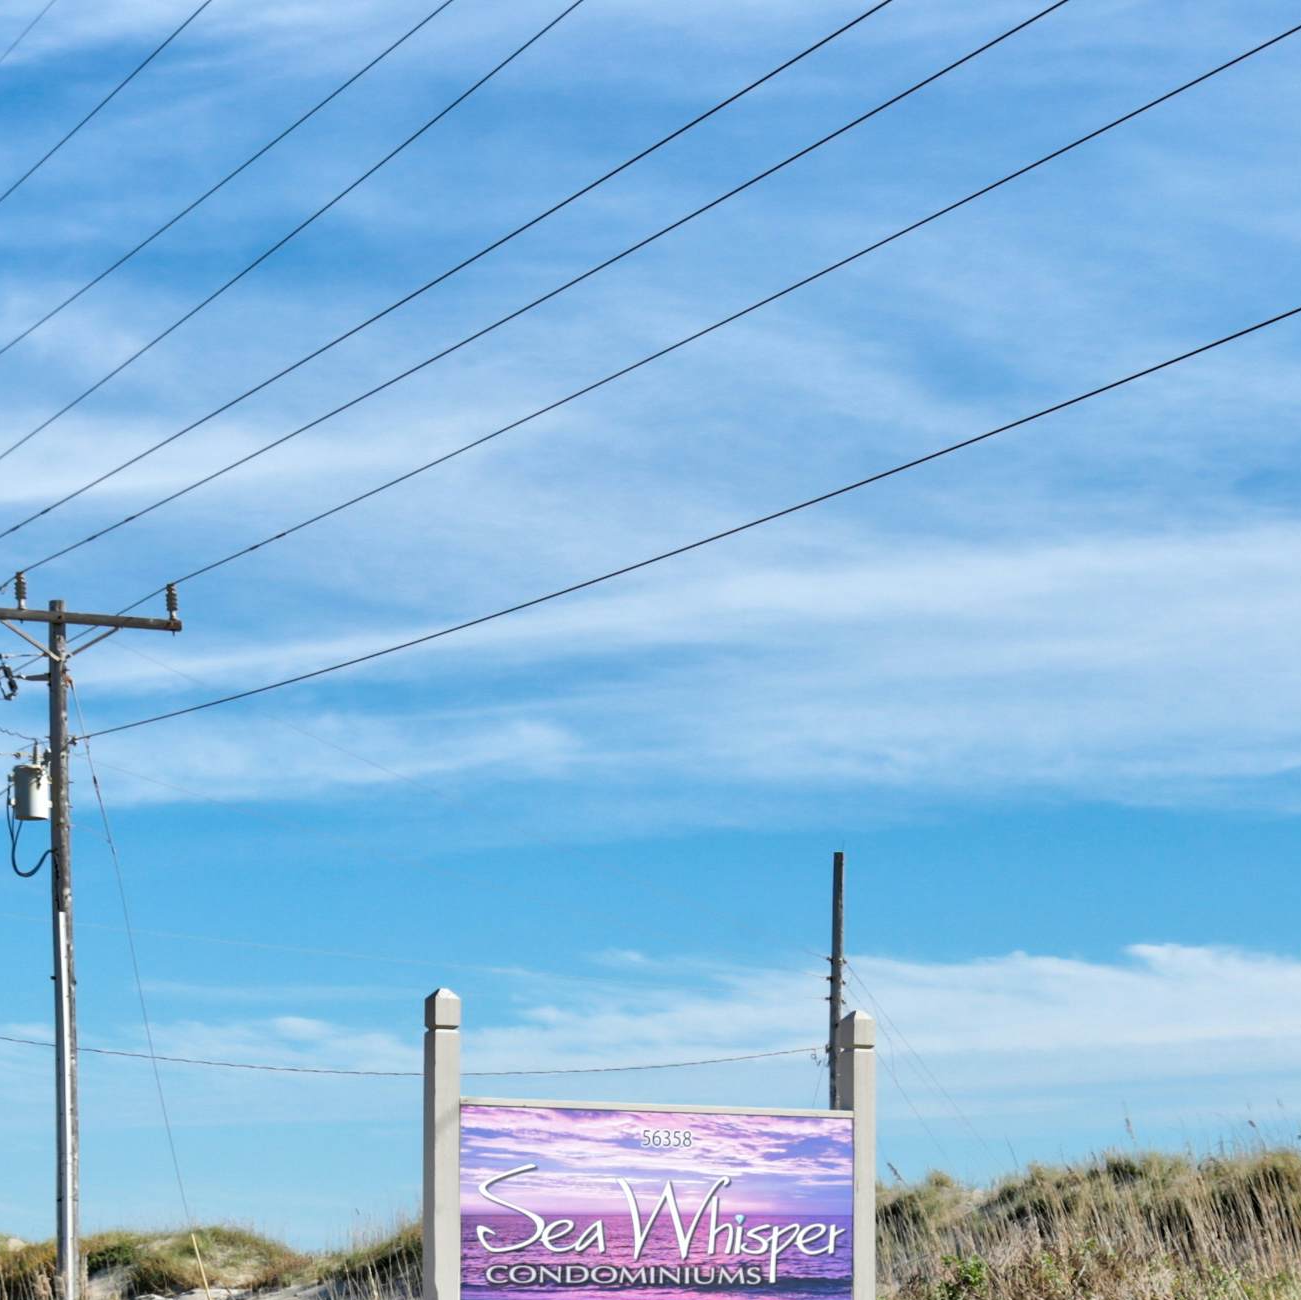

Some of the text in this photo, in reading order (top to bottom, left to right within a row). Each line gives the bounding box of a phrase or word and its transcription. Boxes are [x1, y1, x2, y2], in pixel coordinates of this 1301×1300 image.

[642, 1129, 692, 1147] 56358
[476, 1163, 846, 1284] Sea Whisper
[485, 1264, 763, 1286] CONDOMINIUMS
